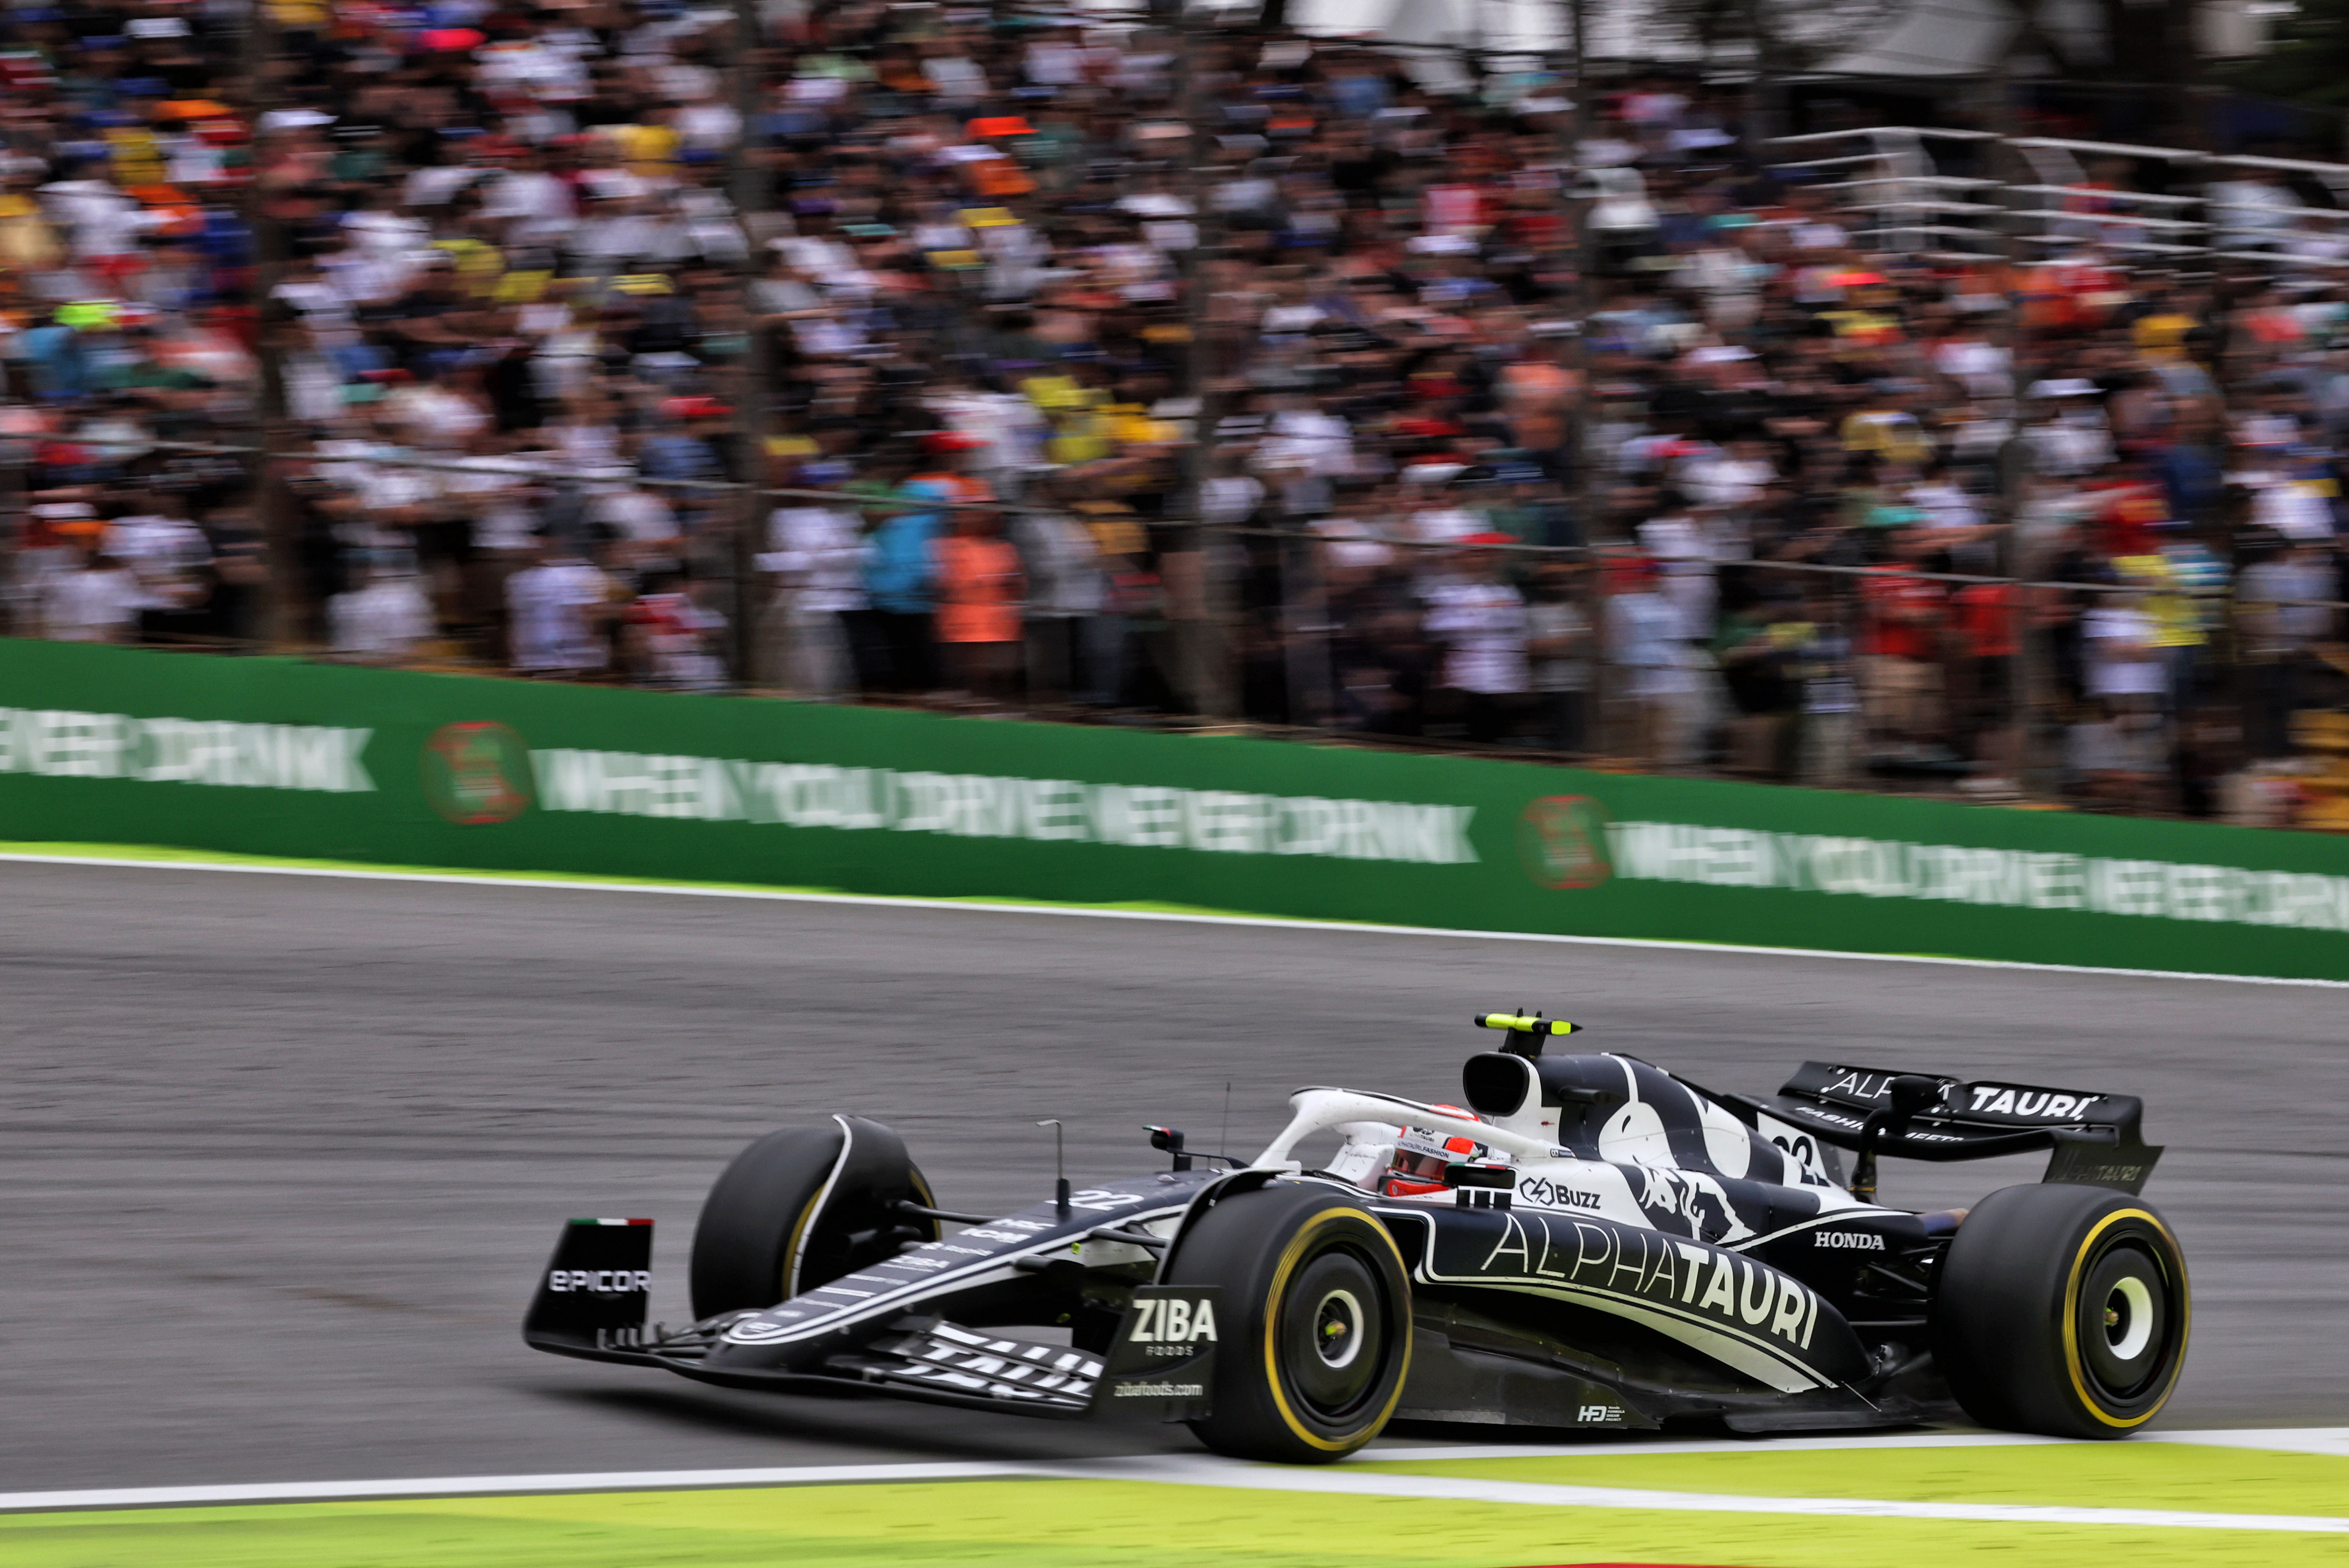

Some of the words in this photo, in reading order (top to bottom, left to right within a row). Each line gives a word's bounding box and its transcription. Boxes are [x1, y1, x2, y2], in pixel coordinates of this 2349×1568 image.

[527, 748, 724, 821] WHEN
[725, 757, 896, 831] YOU
[1969, 1086, 2093, 1119] TAURI
[1814, 1231, 1886, 1250] HONDA
[1129, 1299, 1218, 1342] ZIBA
